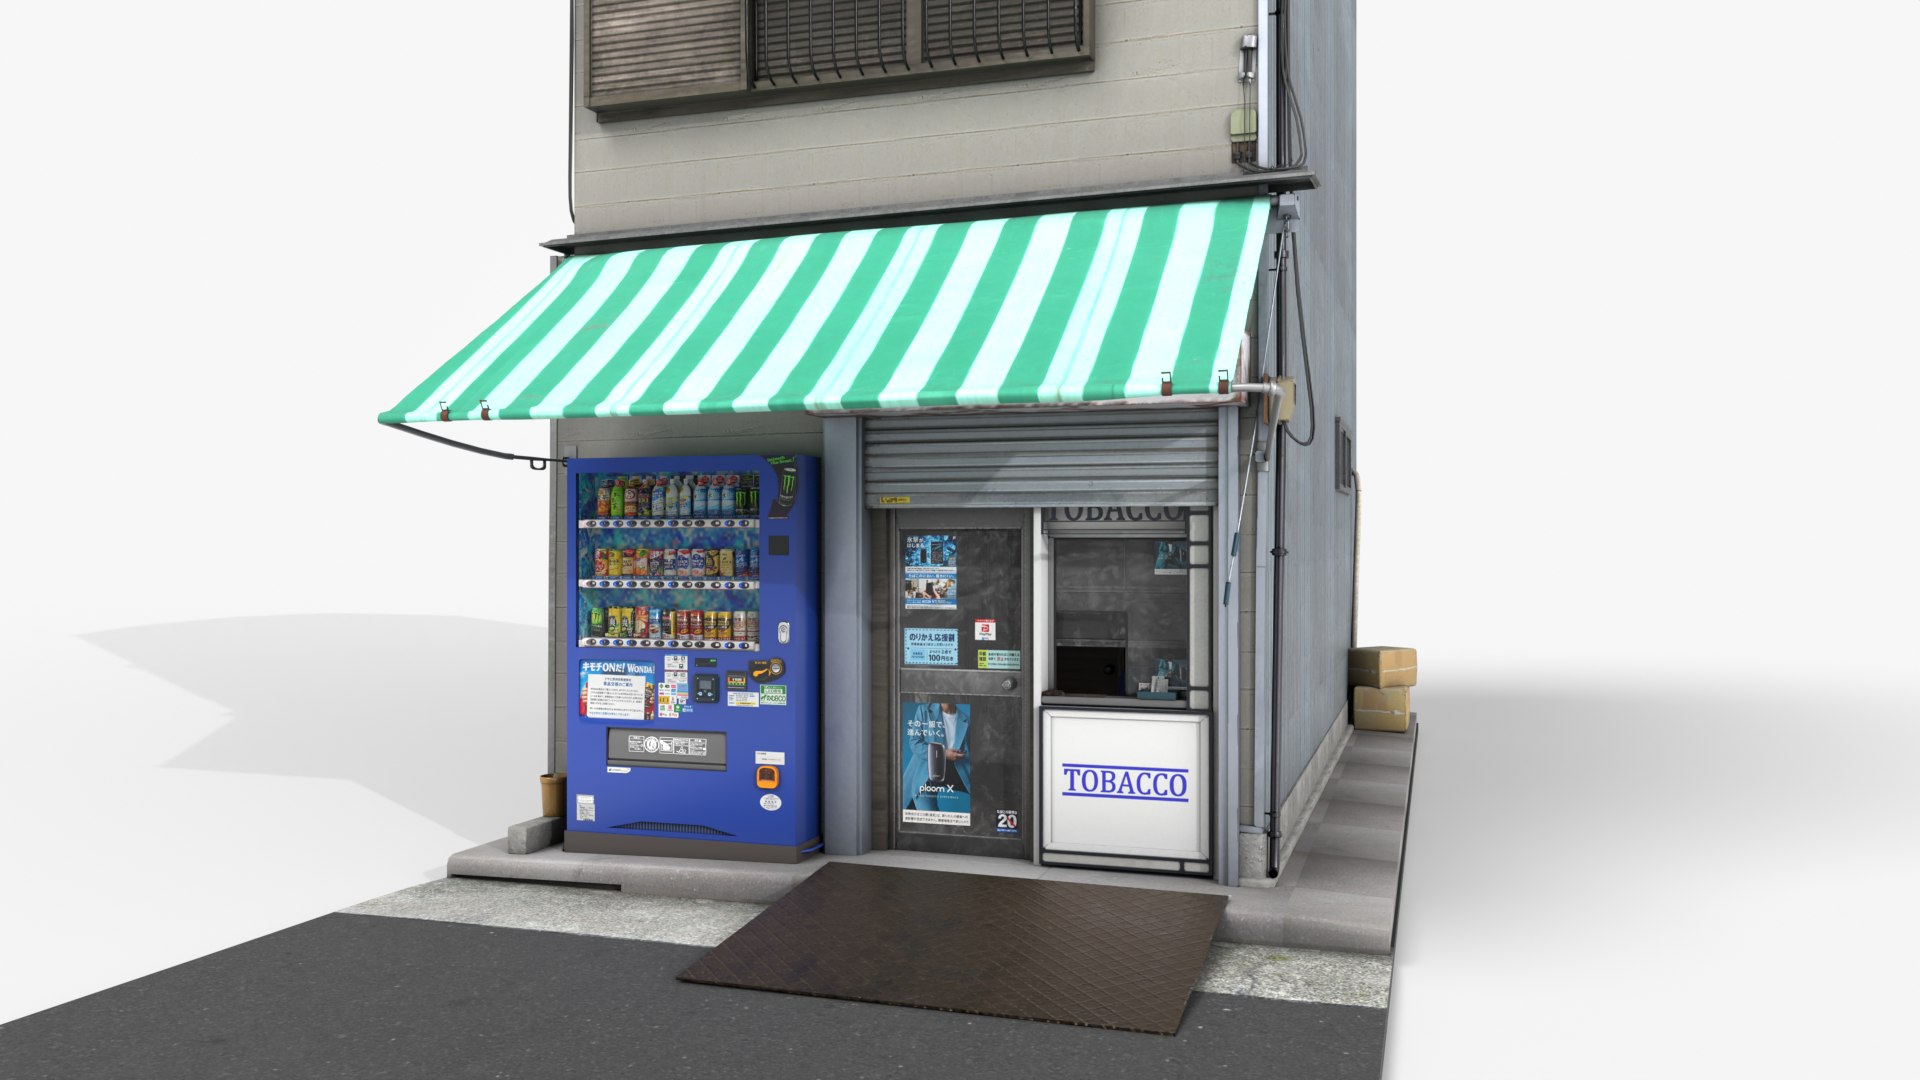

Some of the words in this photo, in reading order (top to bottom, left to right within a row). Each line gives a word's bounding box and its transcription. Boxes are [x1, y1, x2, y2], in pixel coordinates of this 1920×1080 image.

[909, 633, 955, 642] のりかえ応援割
[928, 654, 954, 662] 100円引き
[582, 662, 626, 673] キモチONだ!
[627, 663, 656, 674] WONDA!
[907, 720, 946, 729] その一服で、
[906, 728, 945, 738] 進んでいく。
[1064, 768, 1188, 796] TOBACCO
[920, 784, 945, 794] ploom
[946, 784, 954, 793] X
[997, 814, 1018, 828] 20
